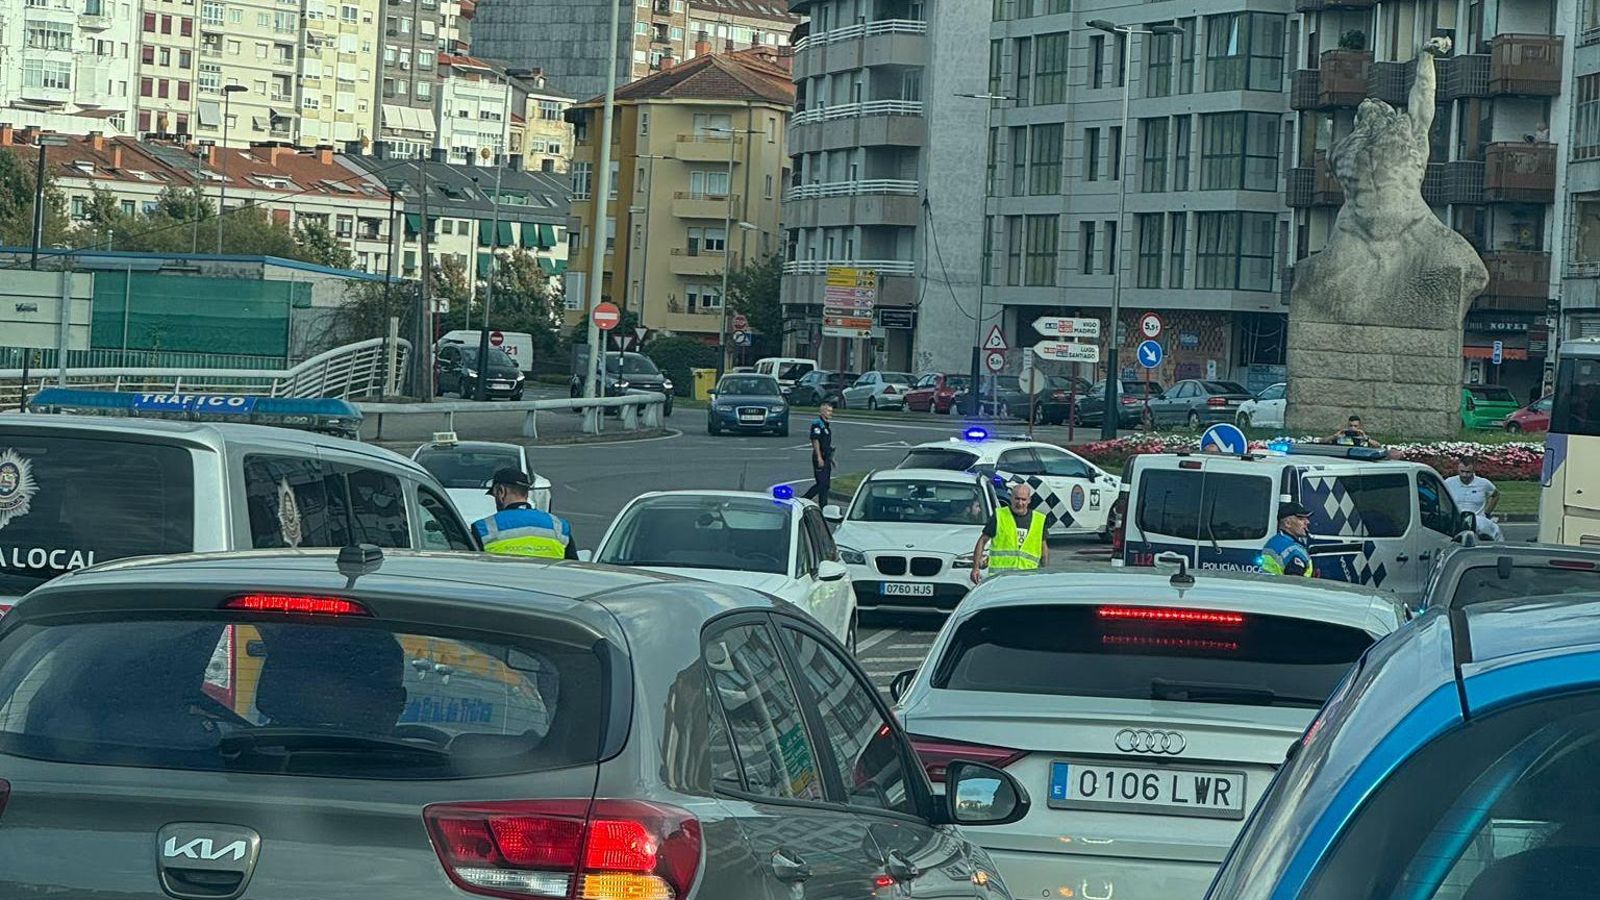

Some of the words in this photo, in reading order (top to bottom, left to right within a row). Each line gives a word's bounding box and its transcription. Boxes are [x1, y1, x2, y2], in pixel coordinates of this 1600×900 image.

[886, 584, 911, 593] 0760
[913, 585, 931, 595] HJS
[1080, 770, 1160, 801] 0106
[1171, 774, 1232, 806] LWR
[164, 836, 247, 861] KIA
